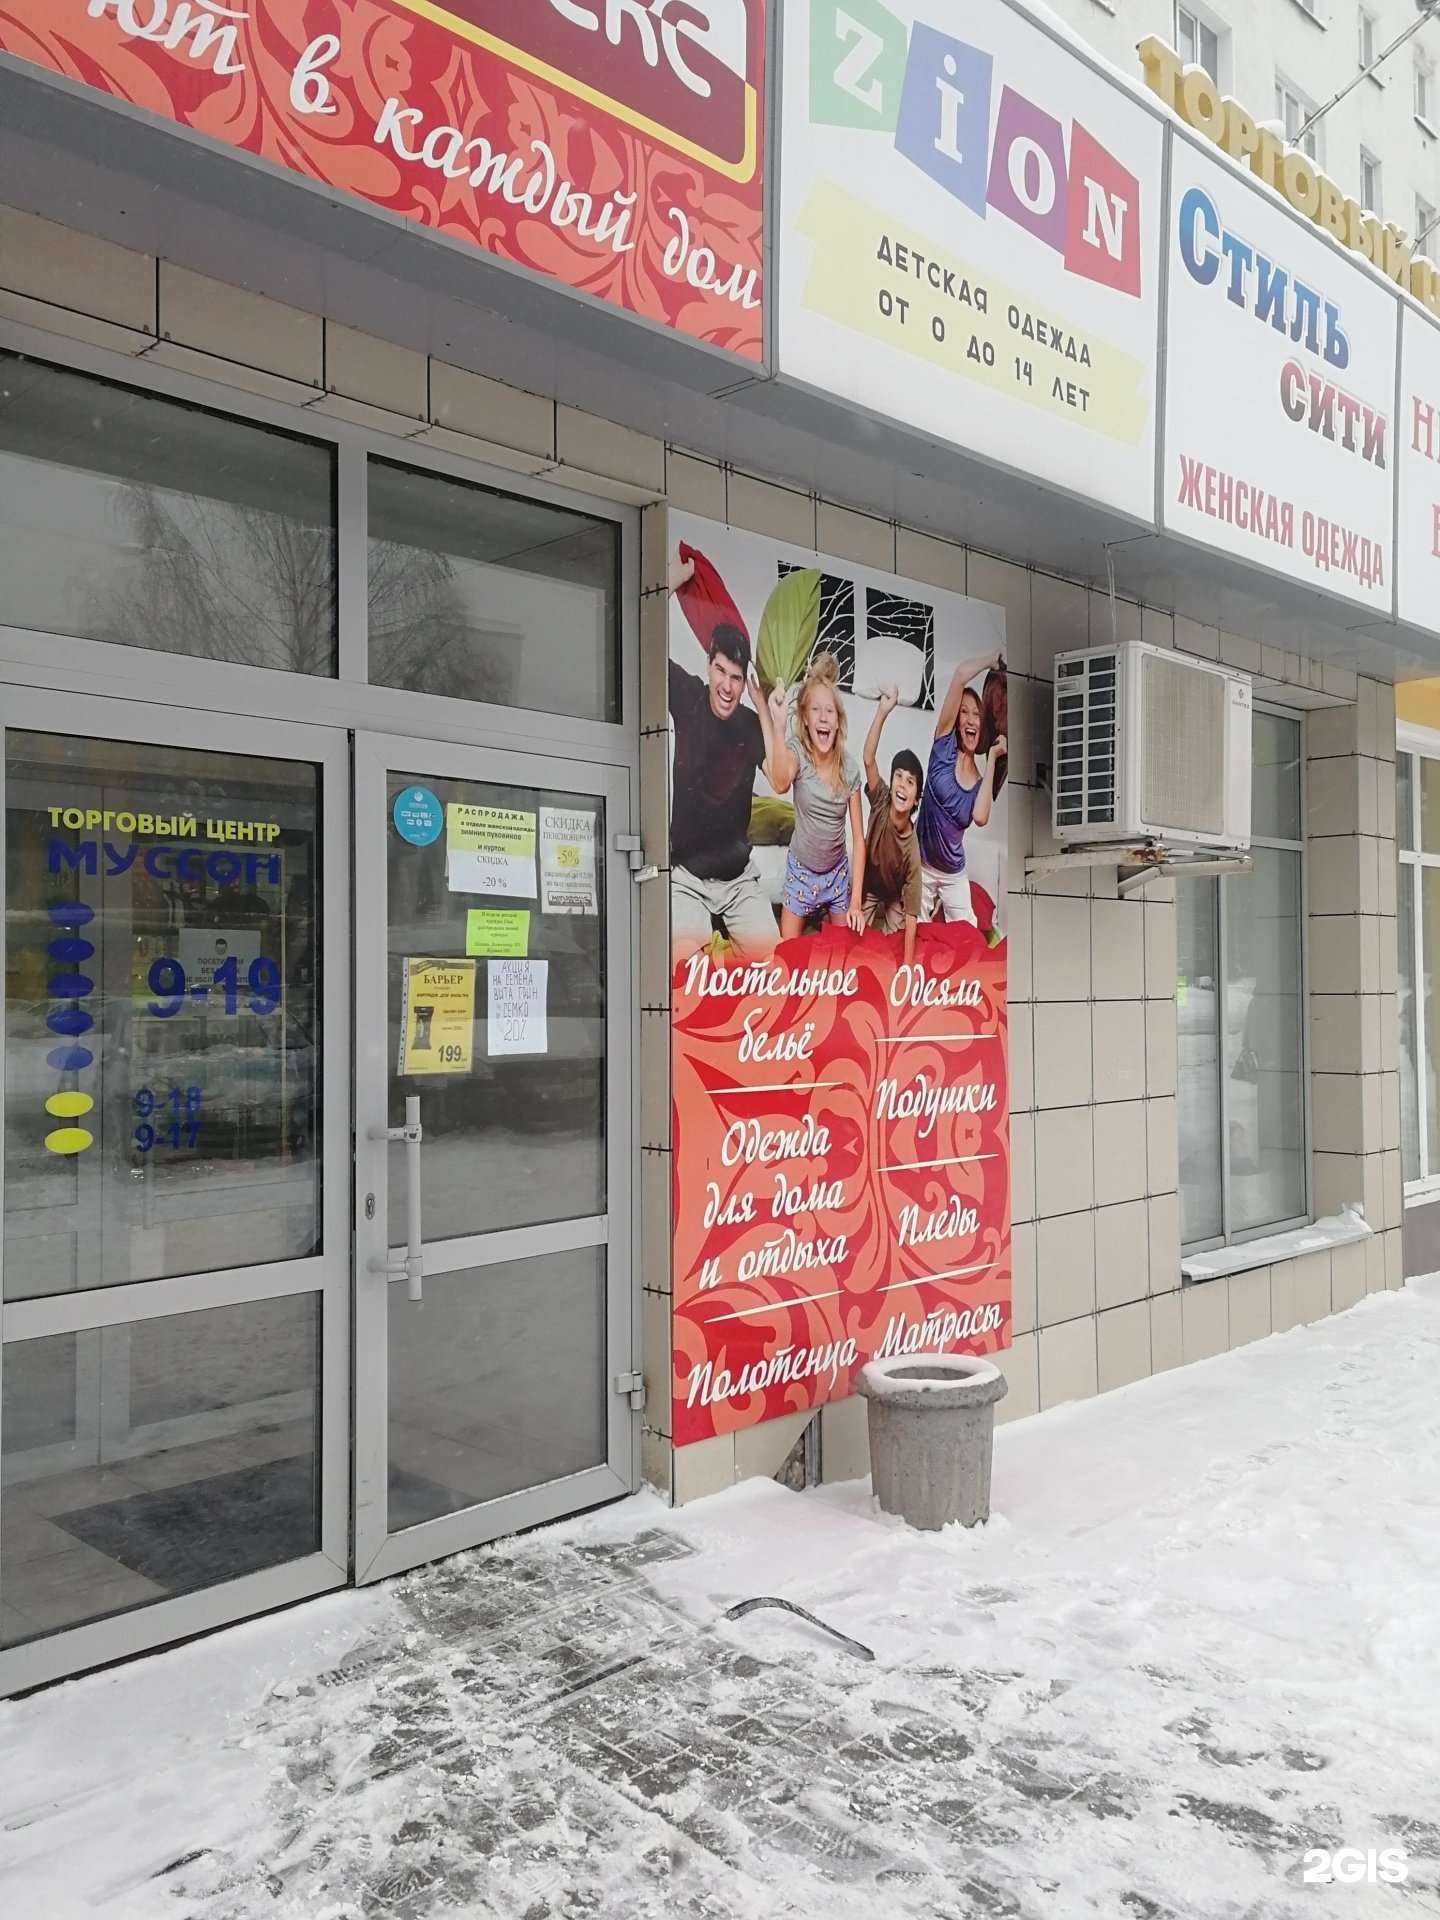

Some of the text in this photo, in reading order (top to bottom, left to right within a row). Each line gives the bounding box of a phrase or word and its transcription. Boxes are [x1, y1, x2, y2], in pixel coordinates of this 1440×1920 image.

[289, 34, 340, 113] в
[374, 97, 638, 253] каждый
[664, 206, 762, 310] дом
[1137, 38, 1413, 293] ТОРГОВЫЙ
[877, 235, 1091, 368] ДЕТСКАЯ ОДЕЖДА
[878, 289, 909, 325] ОТ
[967, 335, 995, 367] ДО
[1015, 357, 1033, 386] 14
[1052, 376, 1090, 412] ЛЕТ
[1177, 454, 1294, 549] ЖЕНСКАЯ
[1302, 510, 1384, 590] ОДЕЖДА
[48, 806, 281, 843] ТОРГОВЫЙ ЦЕНТР
[457, 807, 525, 822] РАСПРОДАЖА
[545, 816, 591, 833] СКИДКА
[47, 839, 280, 884] МУССОН
[477, 855, 509, 867] СКИДКА
[557, 850, 580, 866] -5%
[147, 956, 280, 1019] 9-19
[423, 974, 463, 985] БАРЬЕР
[492, 973, 534, 986] НА СЕМЕНА
[501, 960, 530, 974] АКЦИЯ
[684, 954, 984, 1009] Постельное Одеяла
[503, 1000, 529, 1018] СЕМКО
[503, 1018, 527, 1042] 20%
[438, 1045, 462, 1063] 199
[738, 1006, 814, 1063] бельё
[876, 1078, 998, 1138] Подушки
[134, 1119, 201, 1152] 9-17
[720, 1115, 831, 1167] Одежда
[704, 1178, 847, 1230] для дома
[898, 1203, 980, 1248] Пледы
[698, 1231, 849, 1292] и отдыха
[873, 1302, 1004, 1360] Матрасы
[686, 1335, 860, 1410] Полотенца
